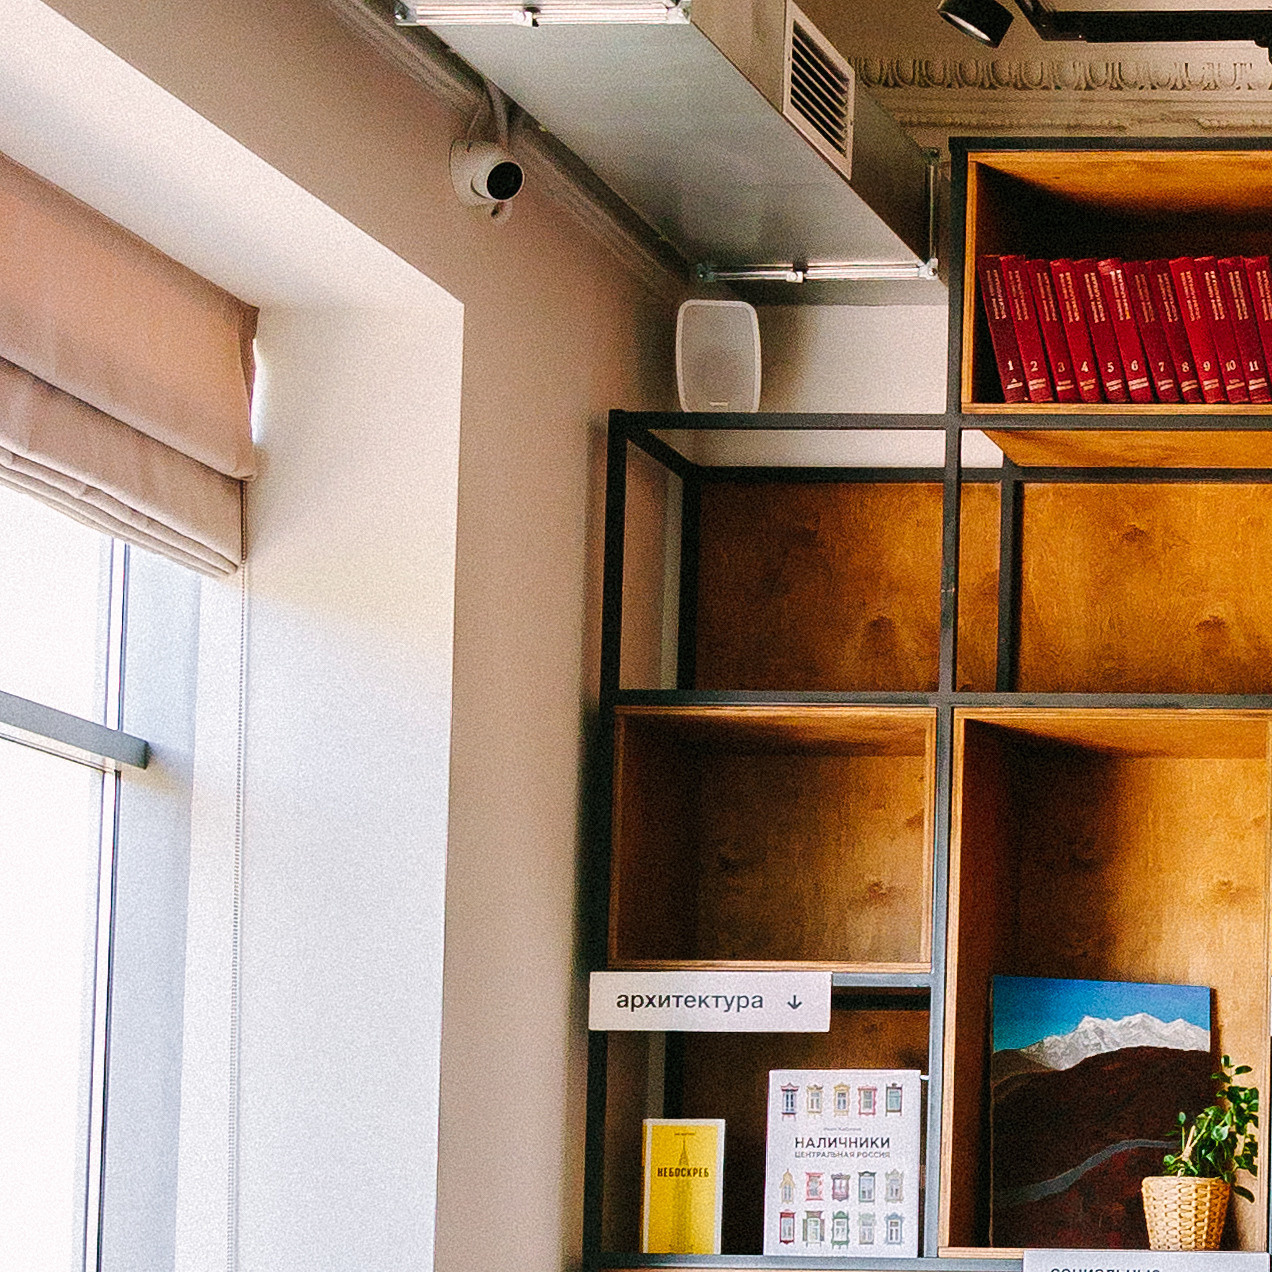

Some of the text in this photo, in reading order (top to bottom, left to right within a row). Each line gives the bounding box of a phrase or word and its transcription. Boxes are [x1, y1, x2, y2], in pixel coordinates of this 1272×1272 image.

[1007, 360, 1014, 371] 1
[1030, 360, 1039, 372] 2
[1057, 361, 1066, 373] 3
[1080, 361, 1089, 373] 4
[1107, 361, 1115, 373] 5
[1130, 359, 1139, 371] 6
[1158, 361, 1165, 372] 7
[1181, 361, 1190, 373] 8
[1203, 360, 1211, 371] 9
[1225, 359, 1236, 372] 10
[1249, 360, 1259, 372] 11
[616, 992, 764, 1014] архитектура
[794, 1136, 890, 1149] НАЛИЧНИКИ
[794, 1150, 891, 1159] ЦЕНТРАЛЬНАЯ РОССИЯ
[657, 1167, 710, 1178] НЕБОСКРЕБ
